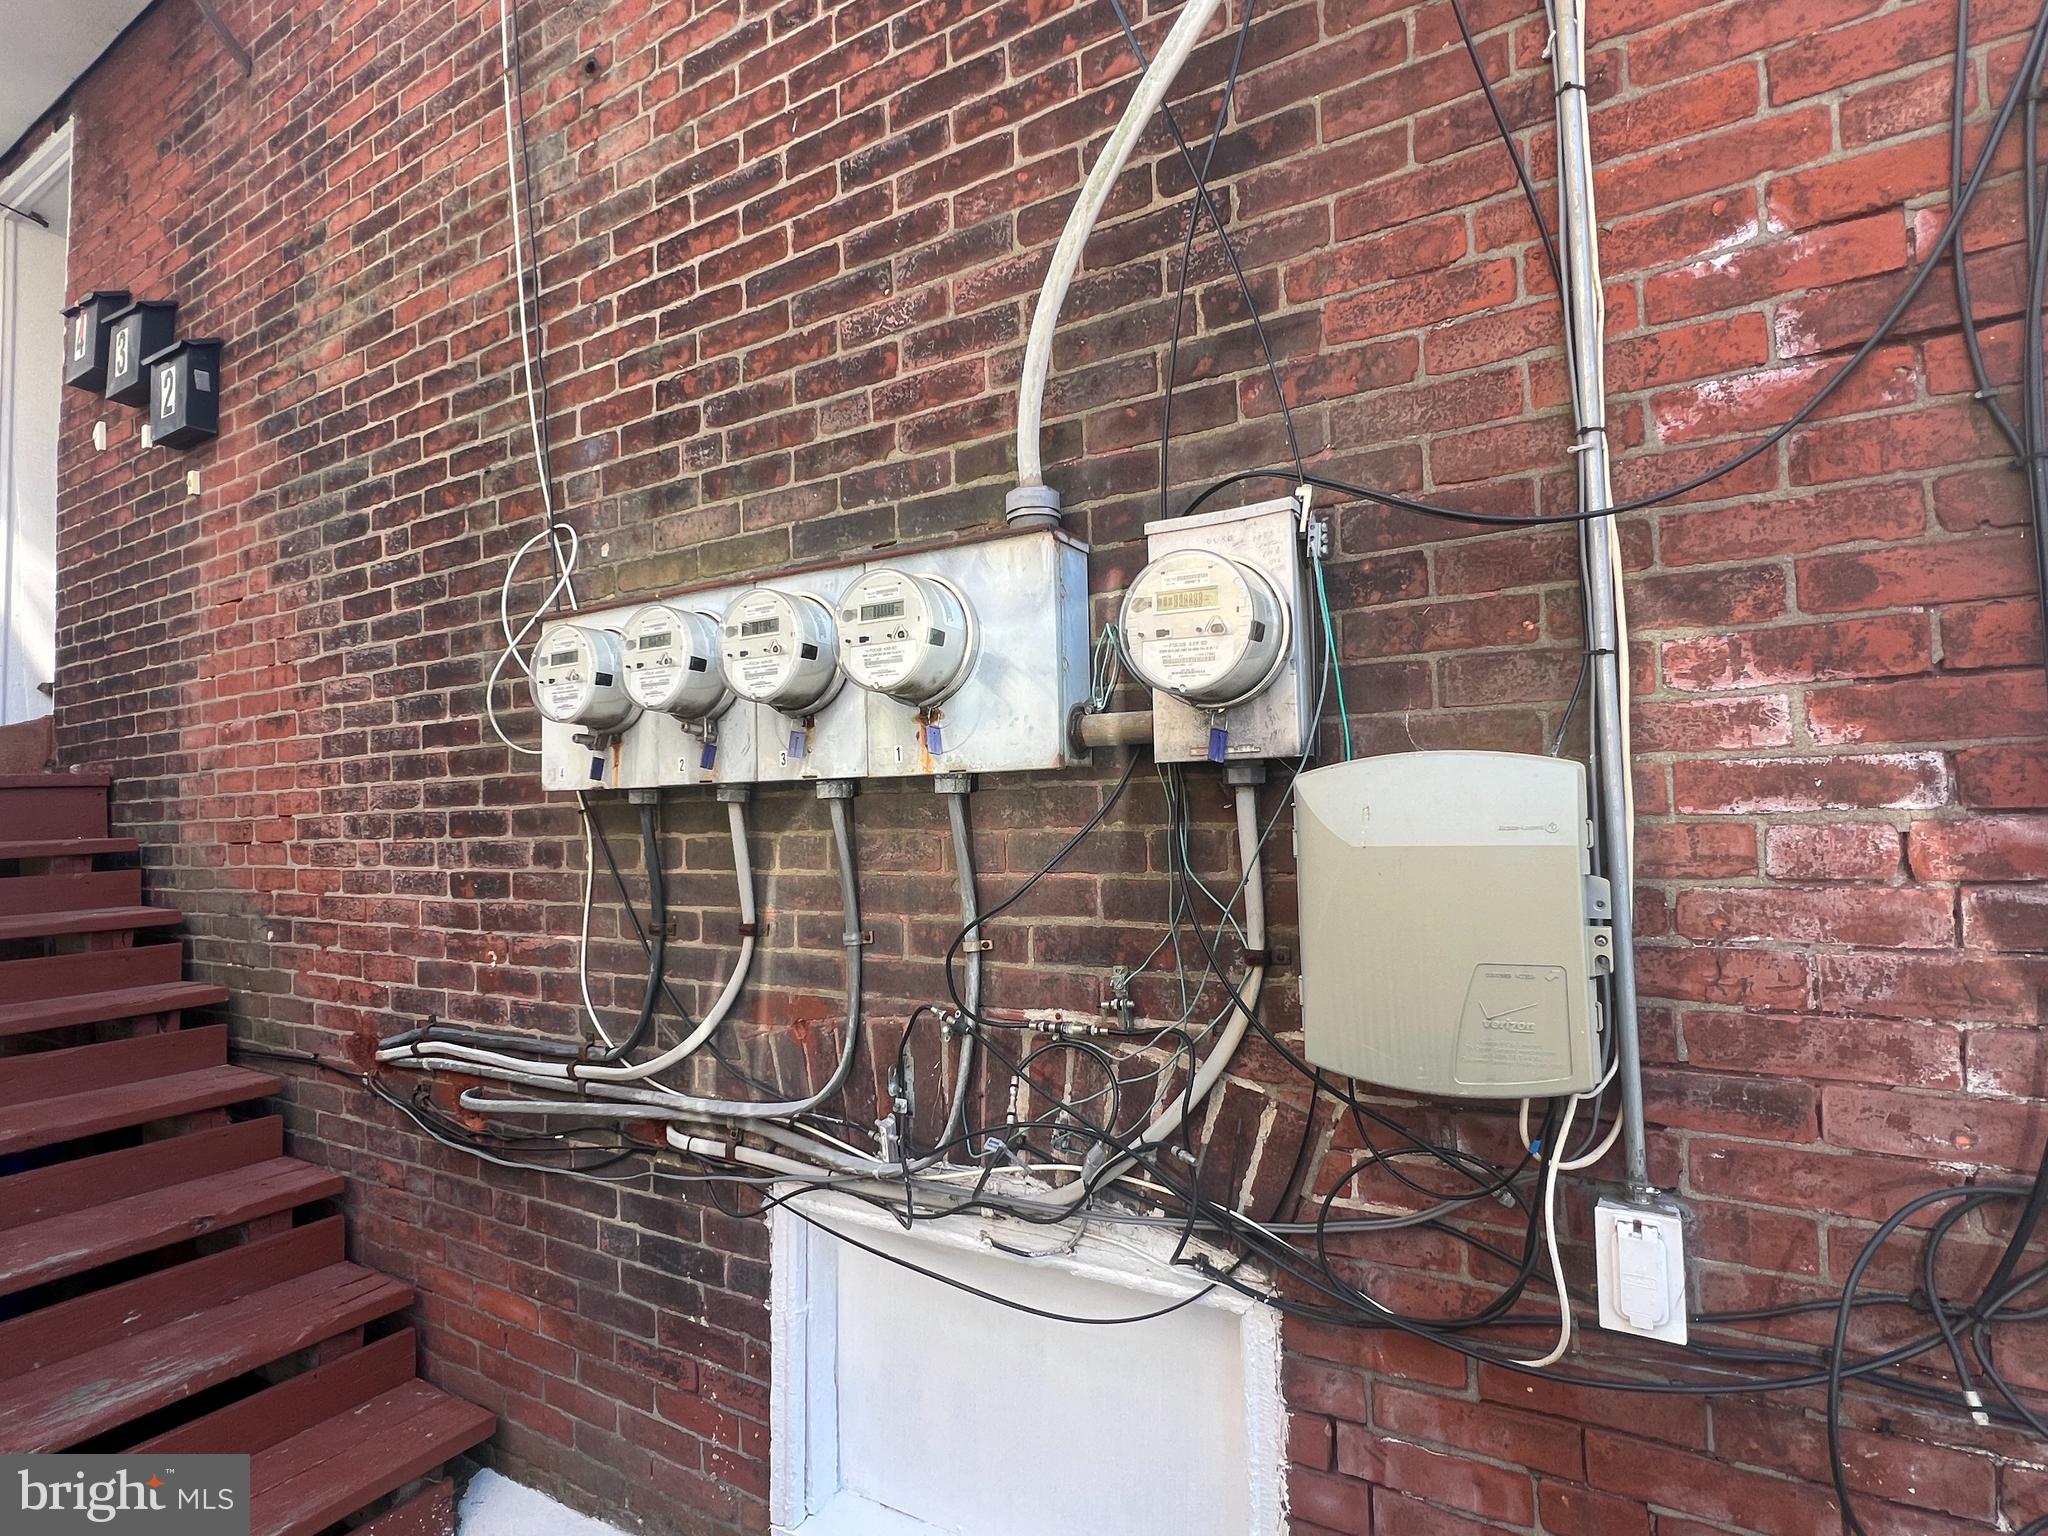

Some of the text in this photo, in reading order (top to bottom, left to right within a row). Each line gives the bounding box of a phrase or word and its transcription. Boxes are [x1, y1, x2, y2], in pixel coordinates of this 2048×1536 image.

[116, 331, 127, 374] 3
[163, 370, 174, 414] 2
[780, 752, 786, 766] 3
[896, 746, 901, 761] 1
[679, 758, 685, 772] 2
